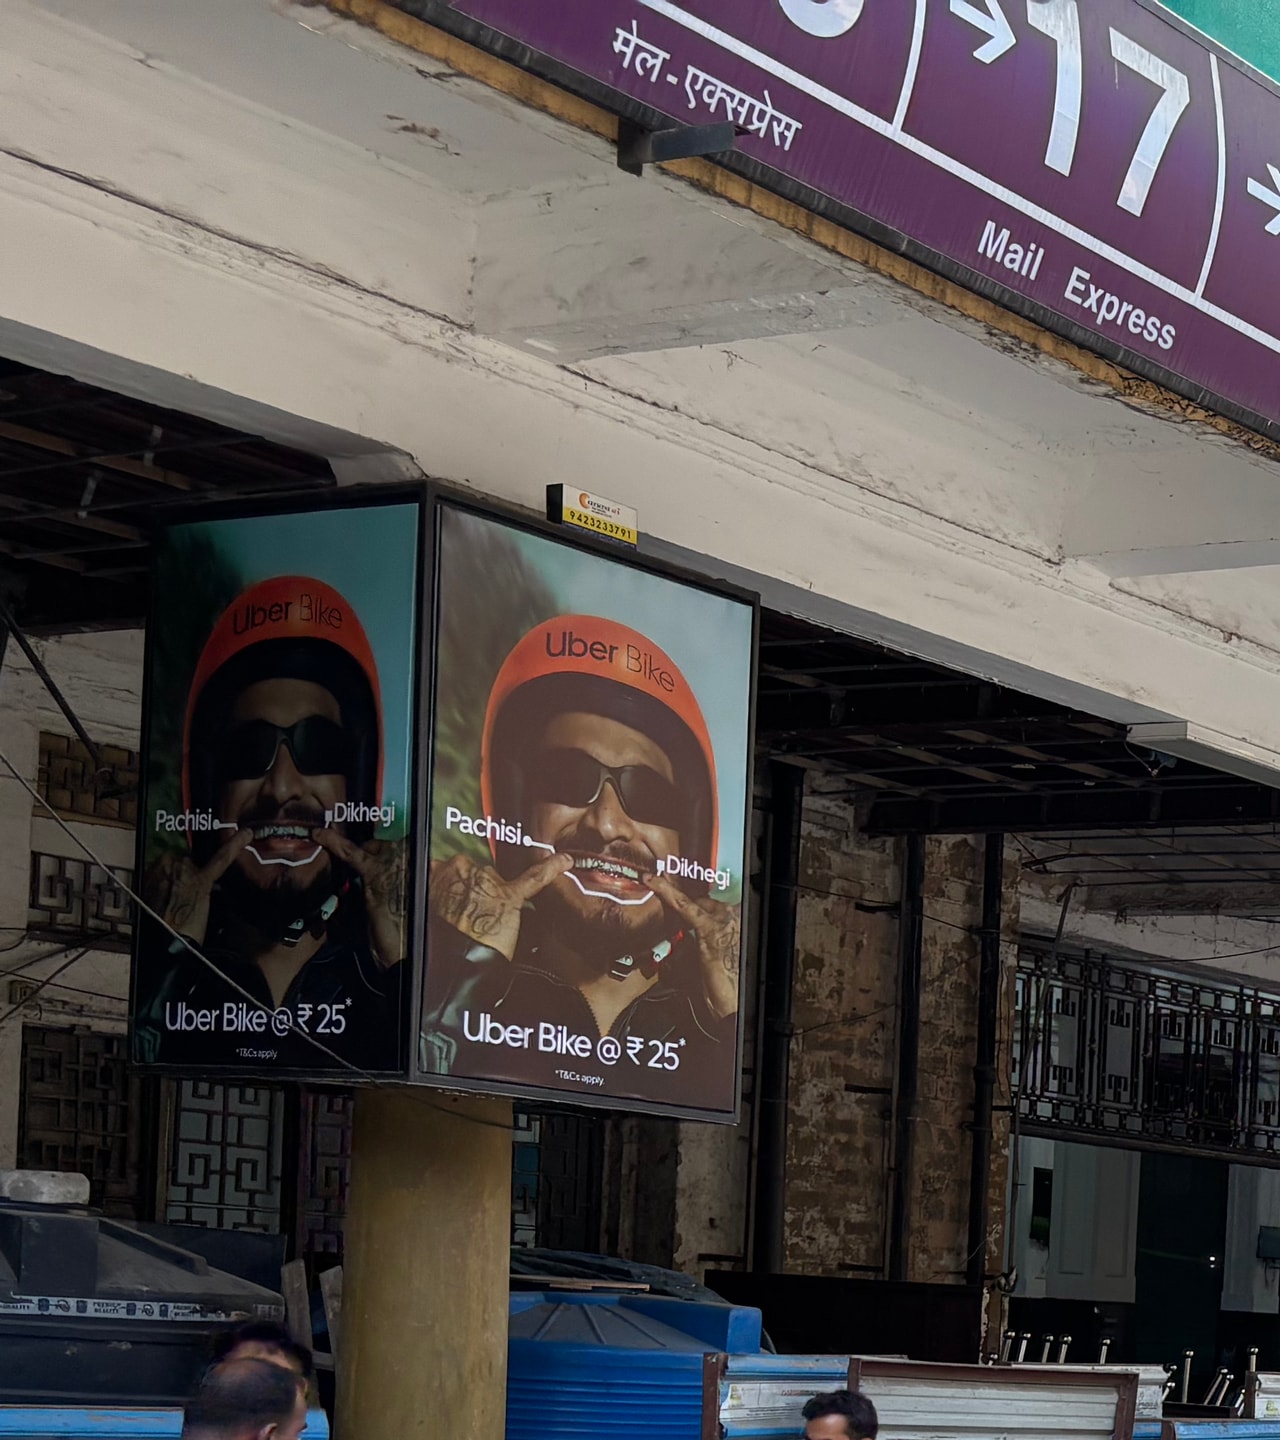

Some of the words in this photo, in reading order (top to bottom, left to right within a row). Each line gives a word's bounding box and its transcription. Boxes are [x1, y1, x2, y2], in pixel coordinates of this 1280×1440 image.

[1027, 0, 1189, 217] 17
[977, 220, 1045, 281] Mail
[1064, 266, 1176, 350] Express
[569, 510, 632, 539] 9423233791
[232, 601, 293, 635] Uber
[300, 593, 343, 630] Bike
[546, 631, 619, 664] Uber
[626, 643, 675, 692] Bike
[155, 808, 213, 832] Pachisi
[333, 801, 396, 828] Dikhegi
[445, 806, 522, 846] Pachisi
[665, 855, 731, 890] Dikhegi
[165, 1002, 220, 1031] Uber
[222, 1002, 268, 1032] Bike
[271, 1007, 293, 1036] @
[463, 1010, 534, 1049] Uber
[538, 1022, 593, 1058] Bike
[597, 1036, 622, 1066] @
